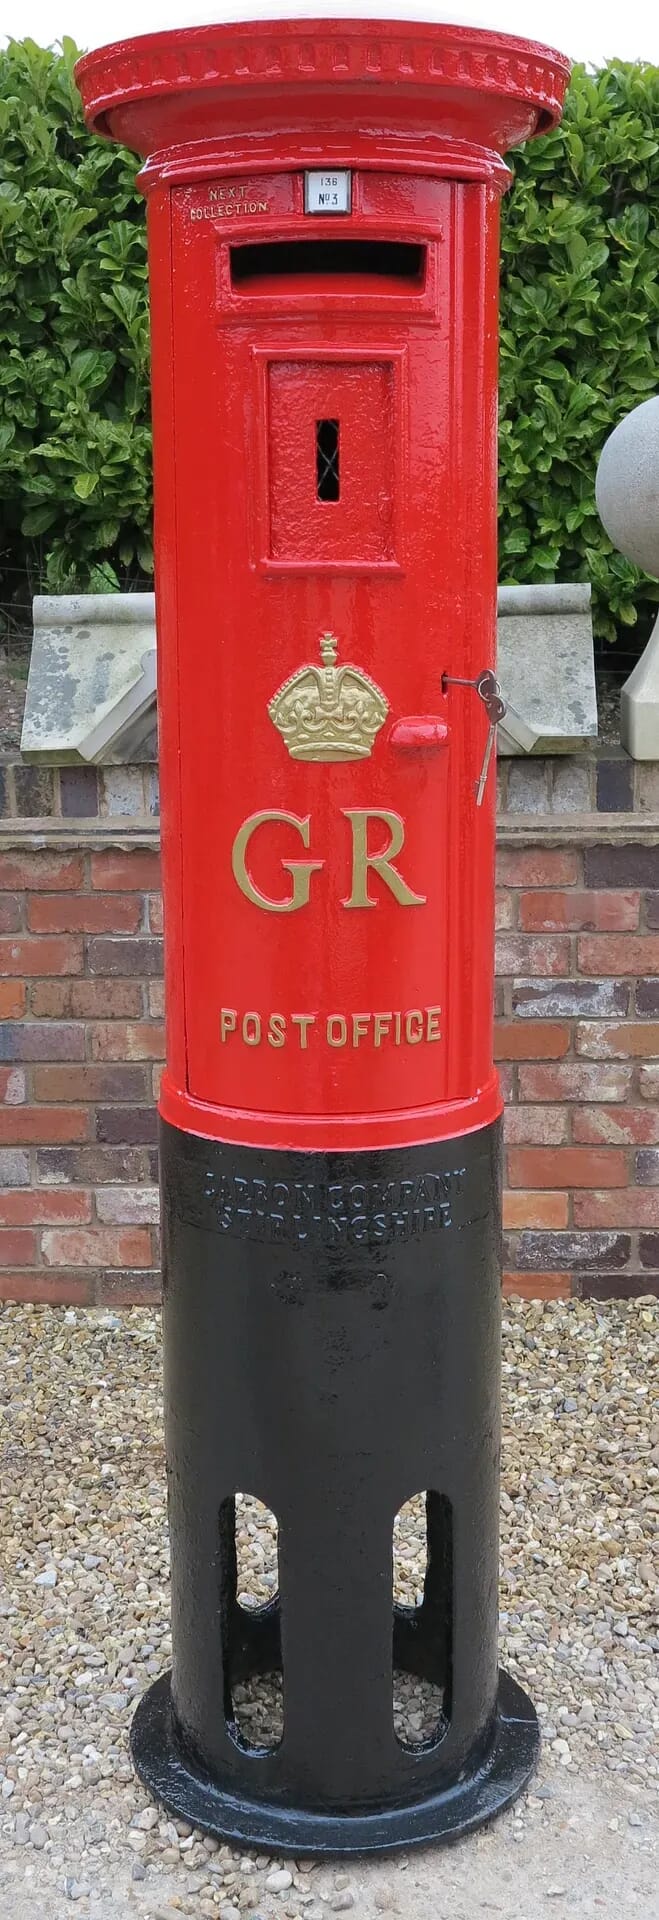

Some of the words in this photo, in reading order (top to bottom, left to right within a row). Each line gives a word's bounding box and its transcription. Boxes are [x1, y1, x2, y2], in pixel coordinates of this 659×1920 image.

[190, 200, 268, 221] COLLECTION
[208, 185, 249, 201] NEXT
[220, 1007, 319, 1049] POST
[326, 1004, 442, 1049] OFFICE
[328, 1167, 467, 1209] COMPANY
[217, 1200, 453, 1241] STIRLINGSHIRE
